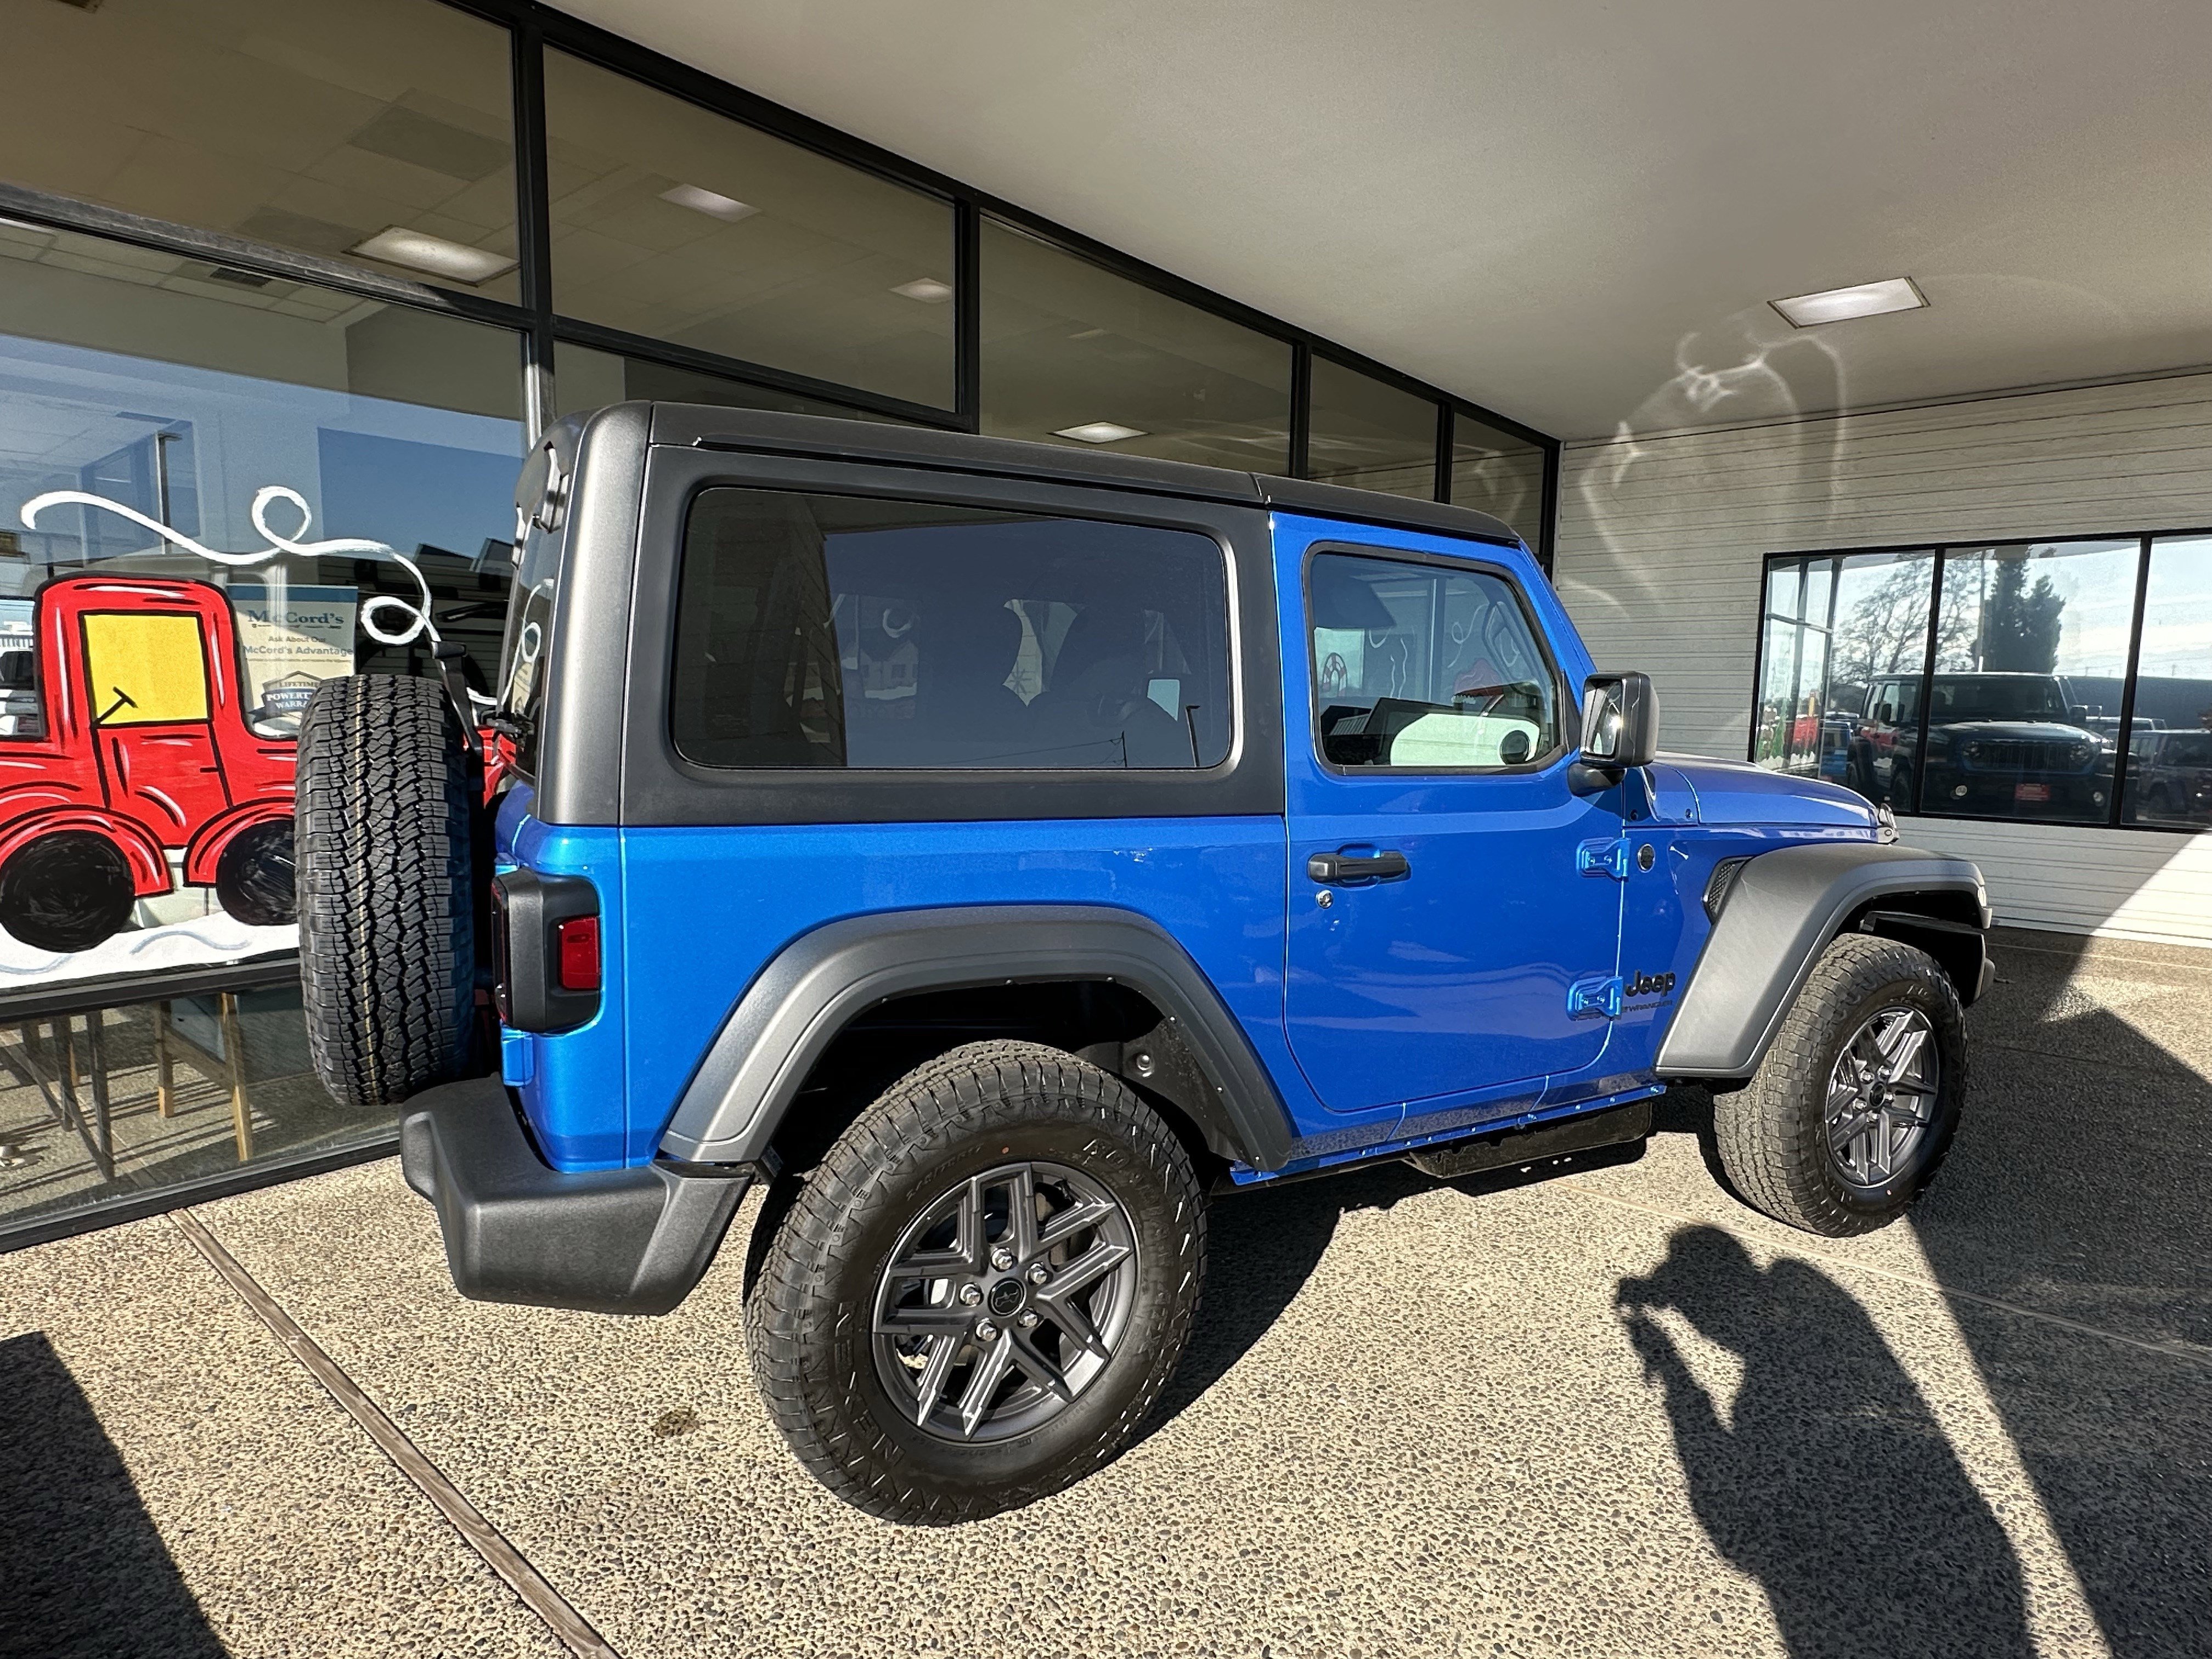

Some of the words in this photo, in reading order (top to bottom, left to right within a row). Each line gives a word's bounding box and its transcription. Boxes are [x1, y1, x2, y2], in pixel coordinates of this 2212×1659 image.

[247, 610, 345, 624] McCord's
[244, 645, 293, 654] McCord's
[295, 646, 353, 657] Advantage
[1625, 969, 1675, 997] Jeep
